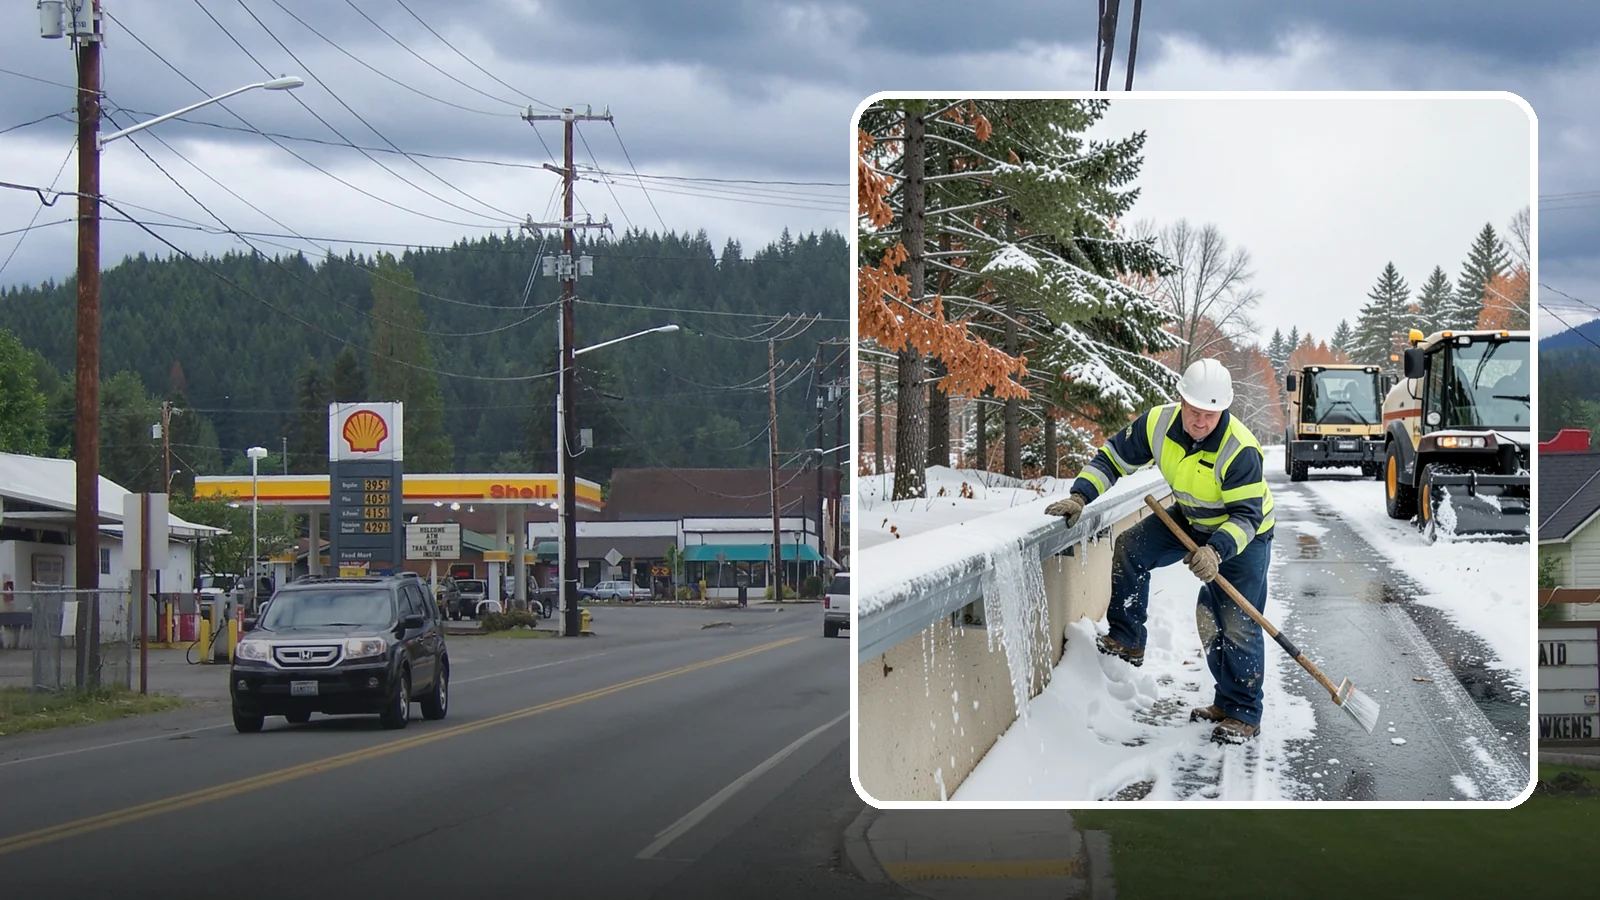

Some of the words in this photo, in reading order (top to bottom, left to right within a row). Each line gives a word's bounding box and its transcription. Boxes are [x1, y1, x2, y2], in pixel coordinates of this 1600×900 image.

[365, 480, 384, 491] 395
[490, 484, 547, 499] Shell
[365, 494, 384, 504] 405
[365, 508, 384, 518] 415
[365, 522, 384, 533] 429
